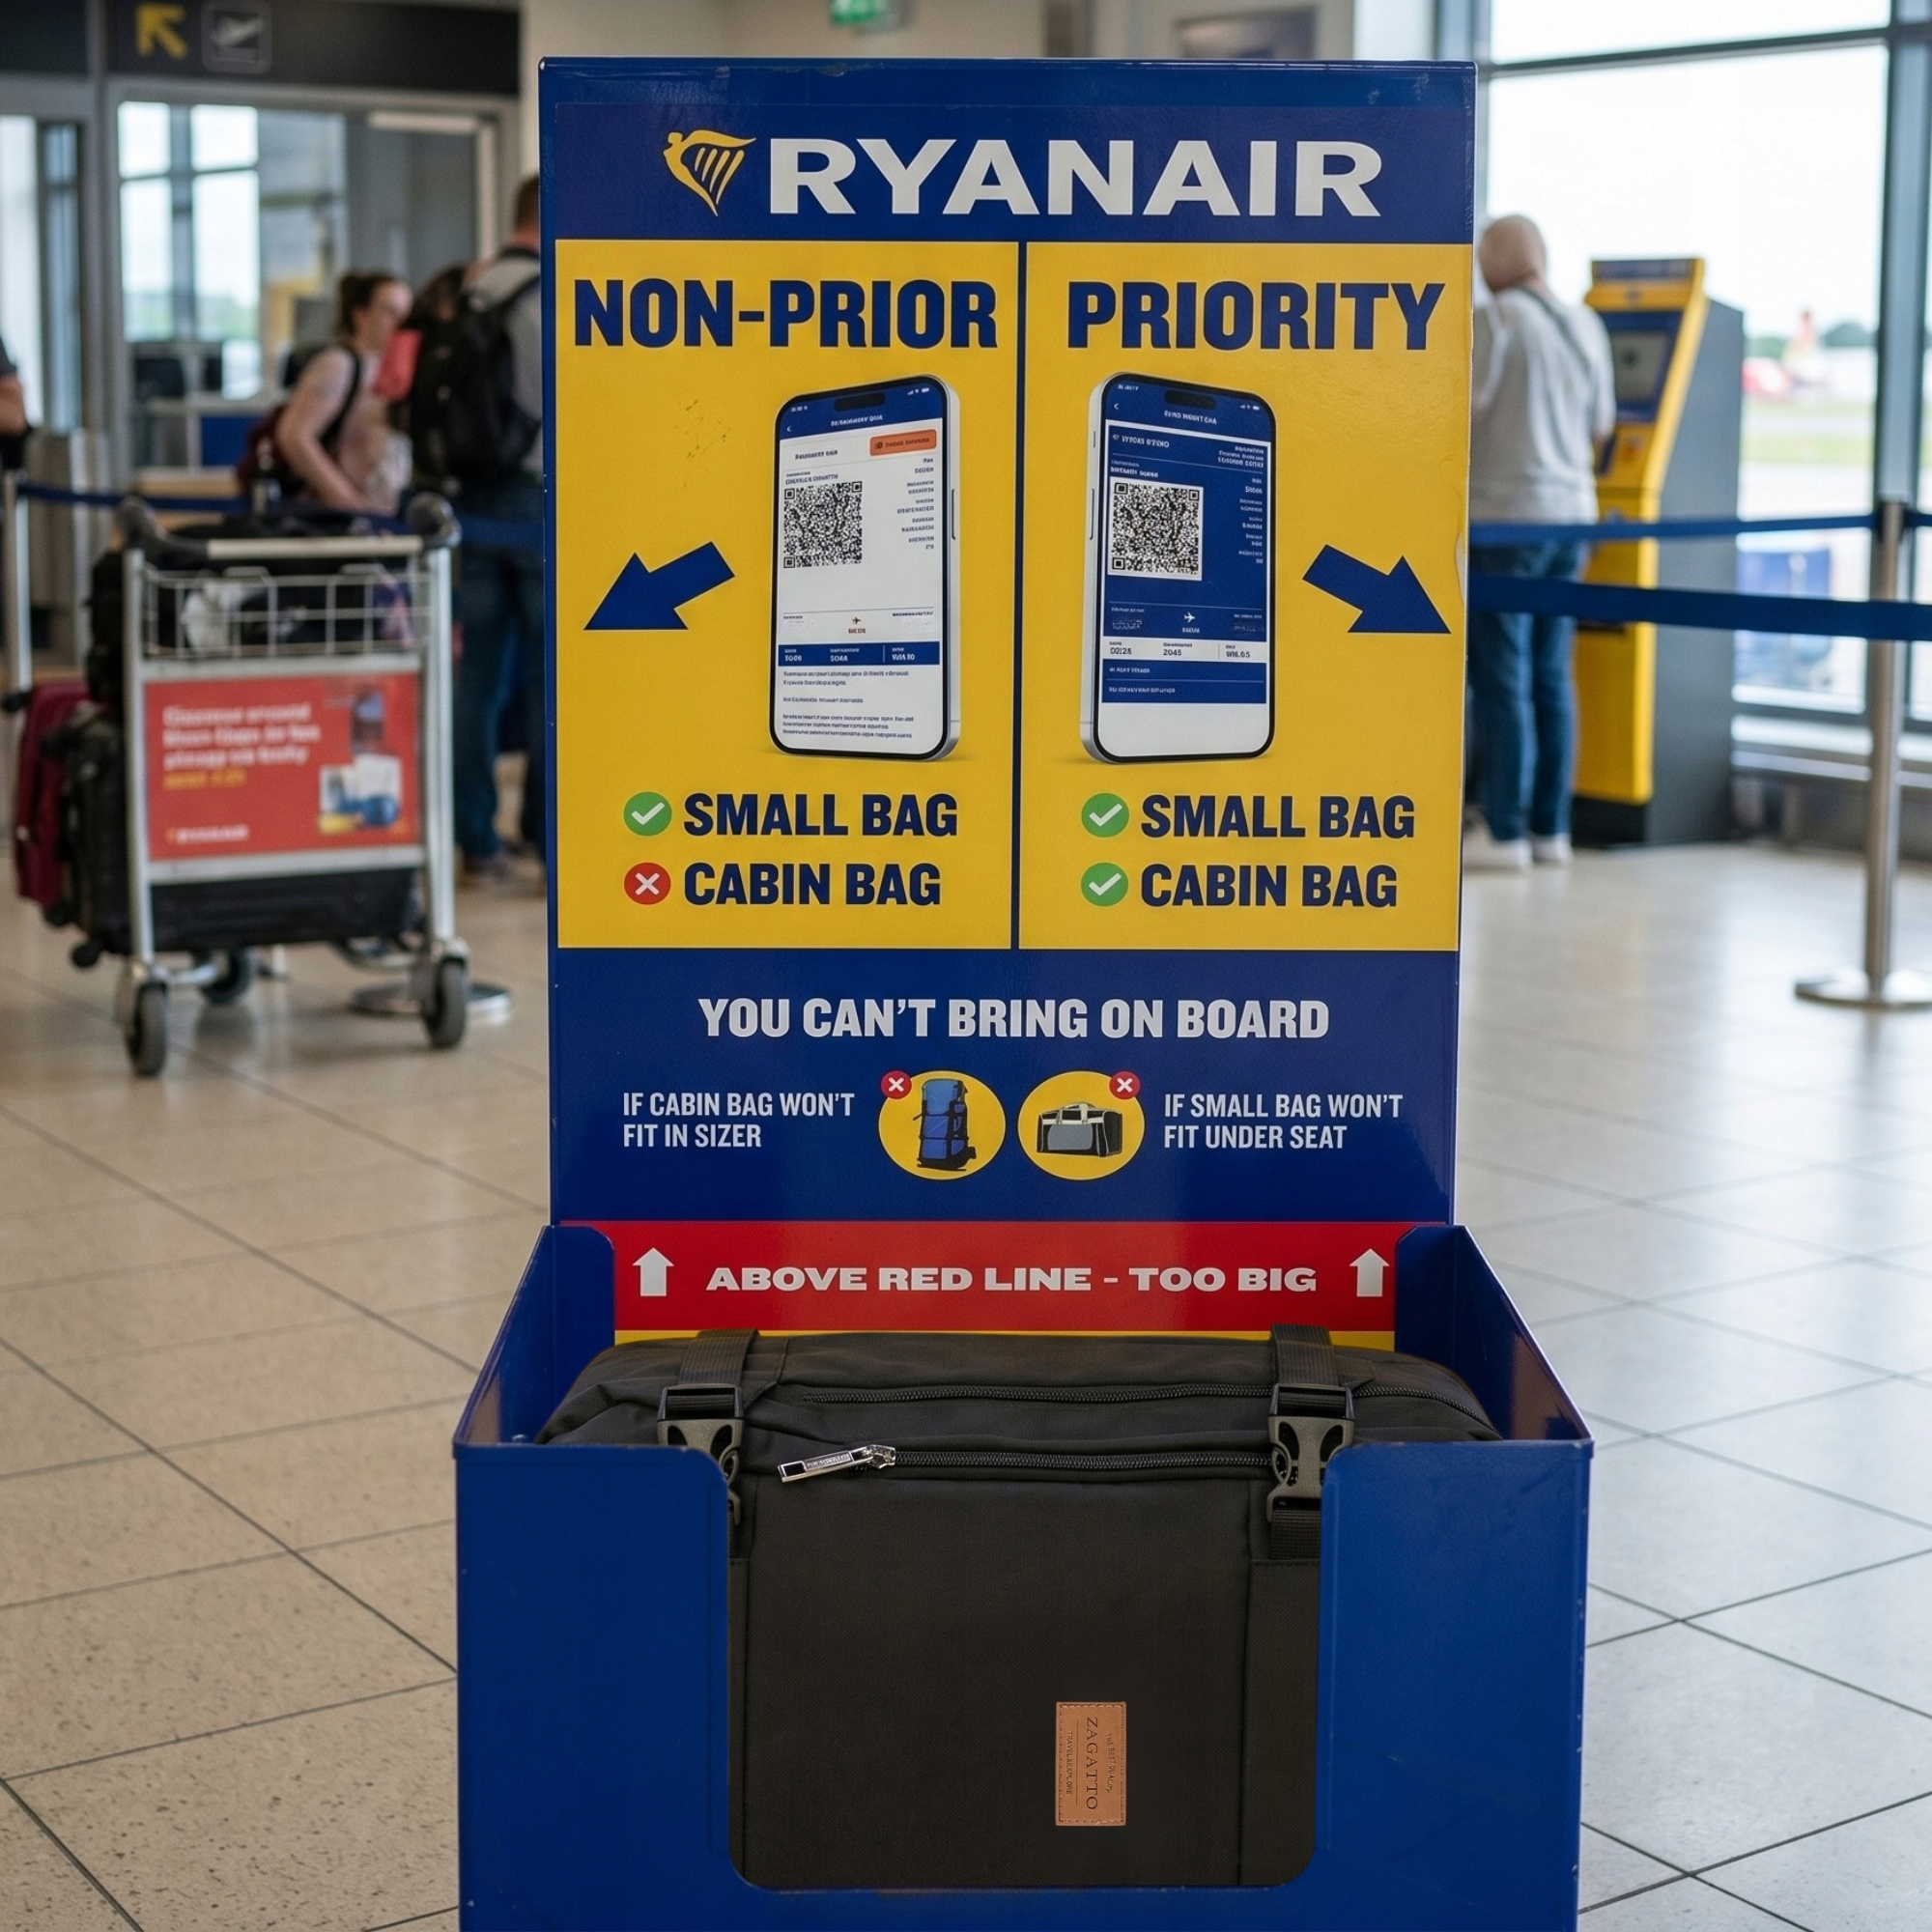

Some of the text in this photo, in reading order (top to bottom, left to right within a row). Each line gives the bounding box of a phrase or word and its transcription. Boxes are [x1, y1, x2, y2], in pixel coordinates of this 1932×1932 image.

[770, 138, 1382, 216] RYANAIR
[574, 277, 998, 350] NON-PRIOR
[1067, 280, 1445, 351] PRIORITY
[683, 792, 957, 838] SMALL BAG
[1141, 794, 1415, 839] SMALL BAG
[684, 862, 941, 906] CABIN BAG
[1141, 863, 1397, 908] CABIN BAG
[697, 997, 1329, 1039] YOU CAN'T BRING ON BOARD
[623, 1092, 855, 1117] IF CABIN BAG WON'T
[1165, 1094, 1404, 1118] IF SMALL BAG WON'T
[623, 1123, 761, 1148] FIT IN SIZER
[1164, 1124, 1348, 1149] FIT UNDER SEAT
[706, 1266, 867, 1292] ABOVE
[878, 1266, 973, 1292] RED
[984, 1266, 1092, 1292] LINE
[1128, 1266, 1226, 1292] TOO
[1237, 1266, 1317, 1292] BIG
[1105, 1733, 1115, 1747] THE
[1086, 1717, 1098, 1810] ZAGATTO
[1105, 1766, 1116, 1794] QUALITY
